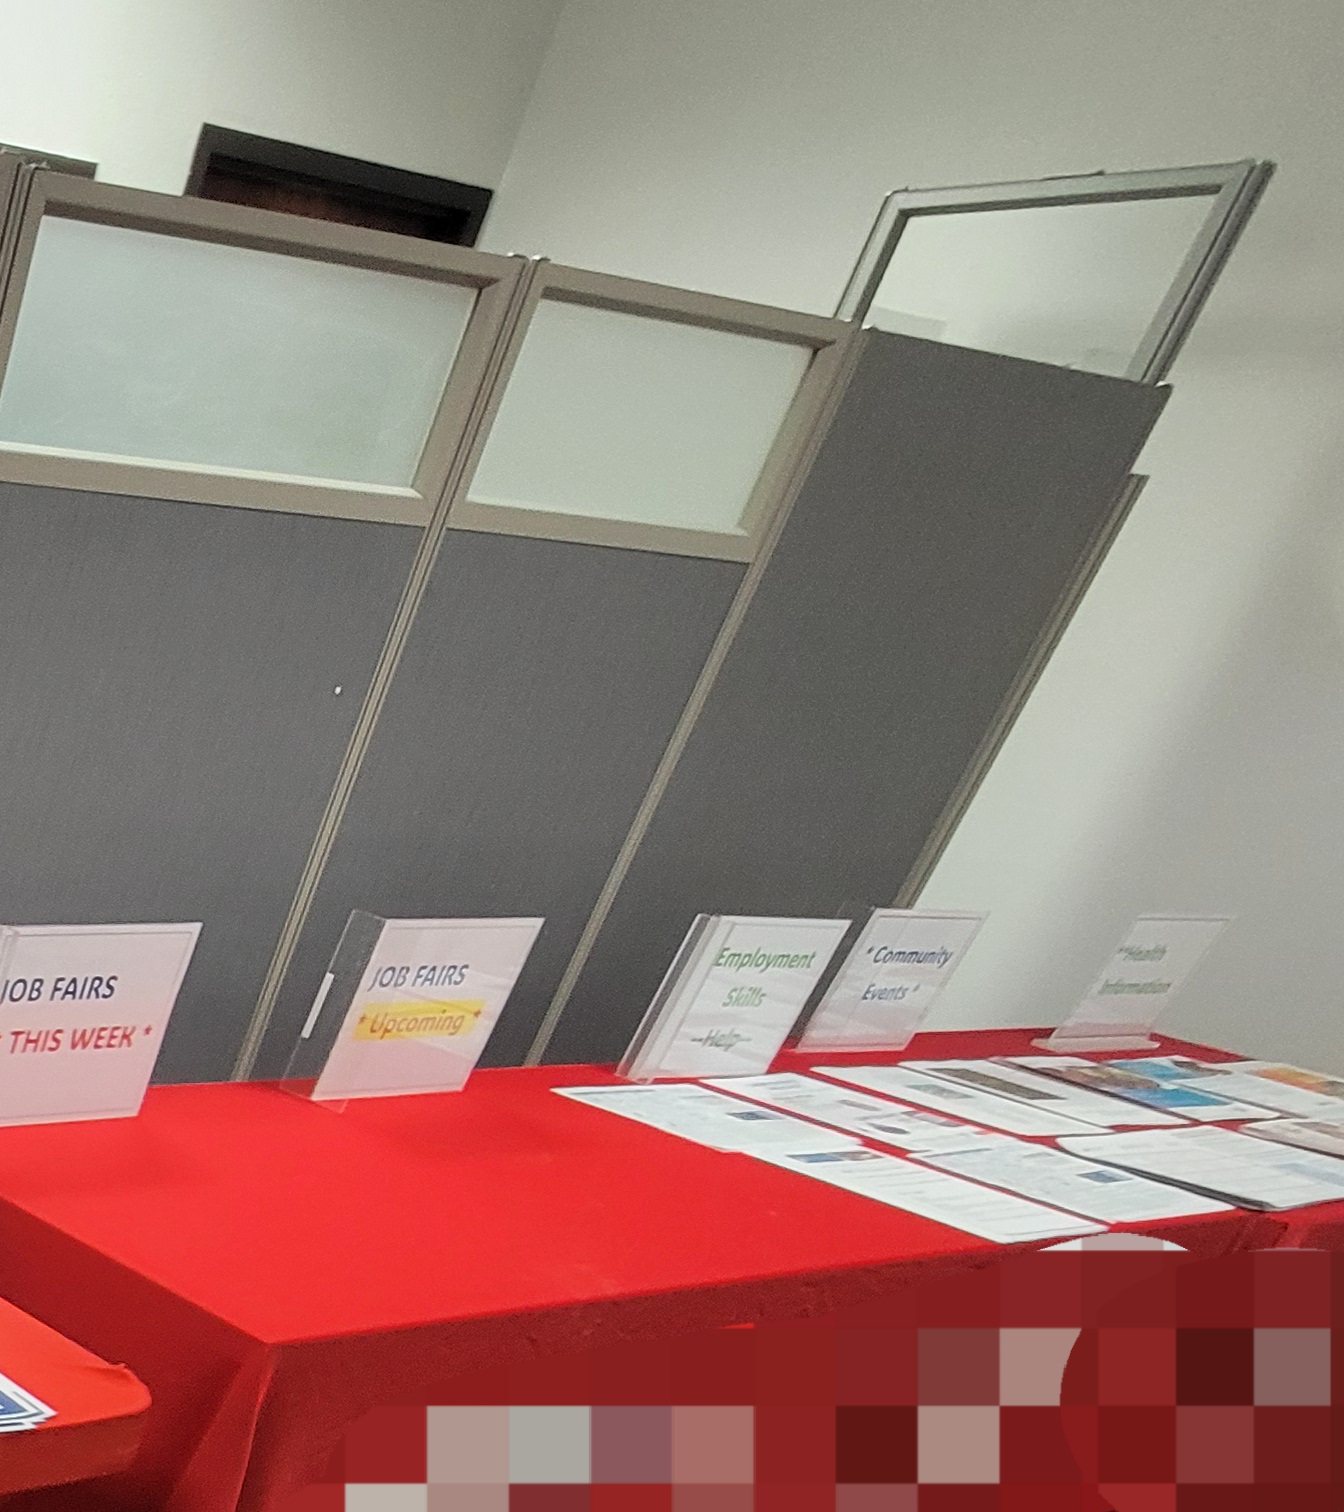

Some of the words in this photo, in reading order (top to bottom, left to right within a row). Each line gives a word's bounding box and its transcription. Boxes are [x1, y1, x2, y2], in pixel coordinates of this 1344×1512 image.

[712, 946, 816, 973] Employment
[872, 946, 954, 968] Community
[0, 978, 44, 1005] JOB
[49, 975, 118, 1001] FAIRS
[367, 966, 411, 992] JOB
[411, 964, 470, 988] FAIRS
[721, 985, 767, 1008] Skills
[861, 983, 910, 1001] Events
[369, 1008, 466, 1039] Upcoming
[10, 1028, 65, 1054] THIS
[70, 1025, 137, 1051] WEEK
